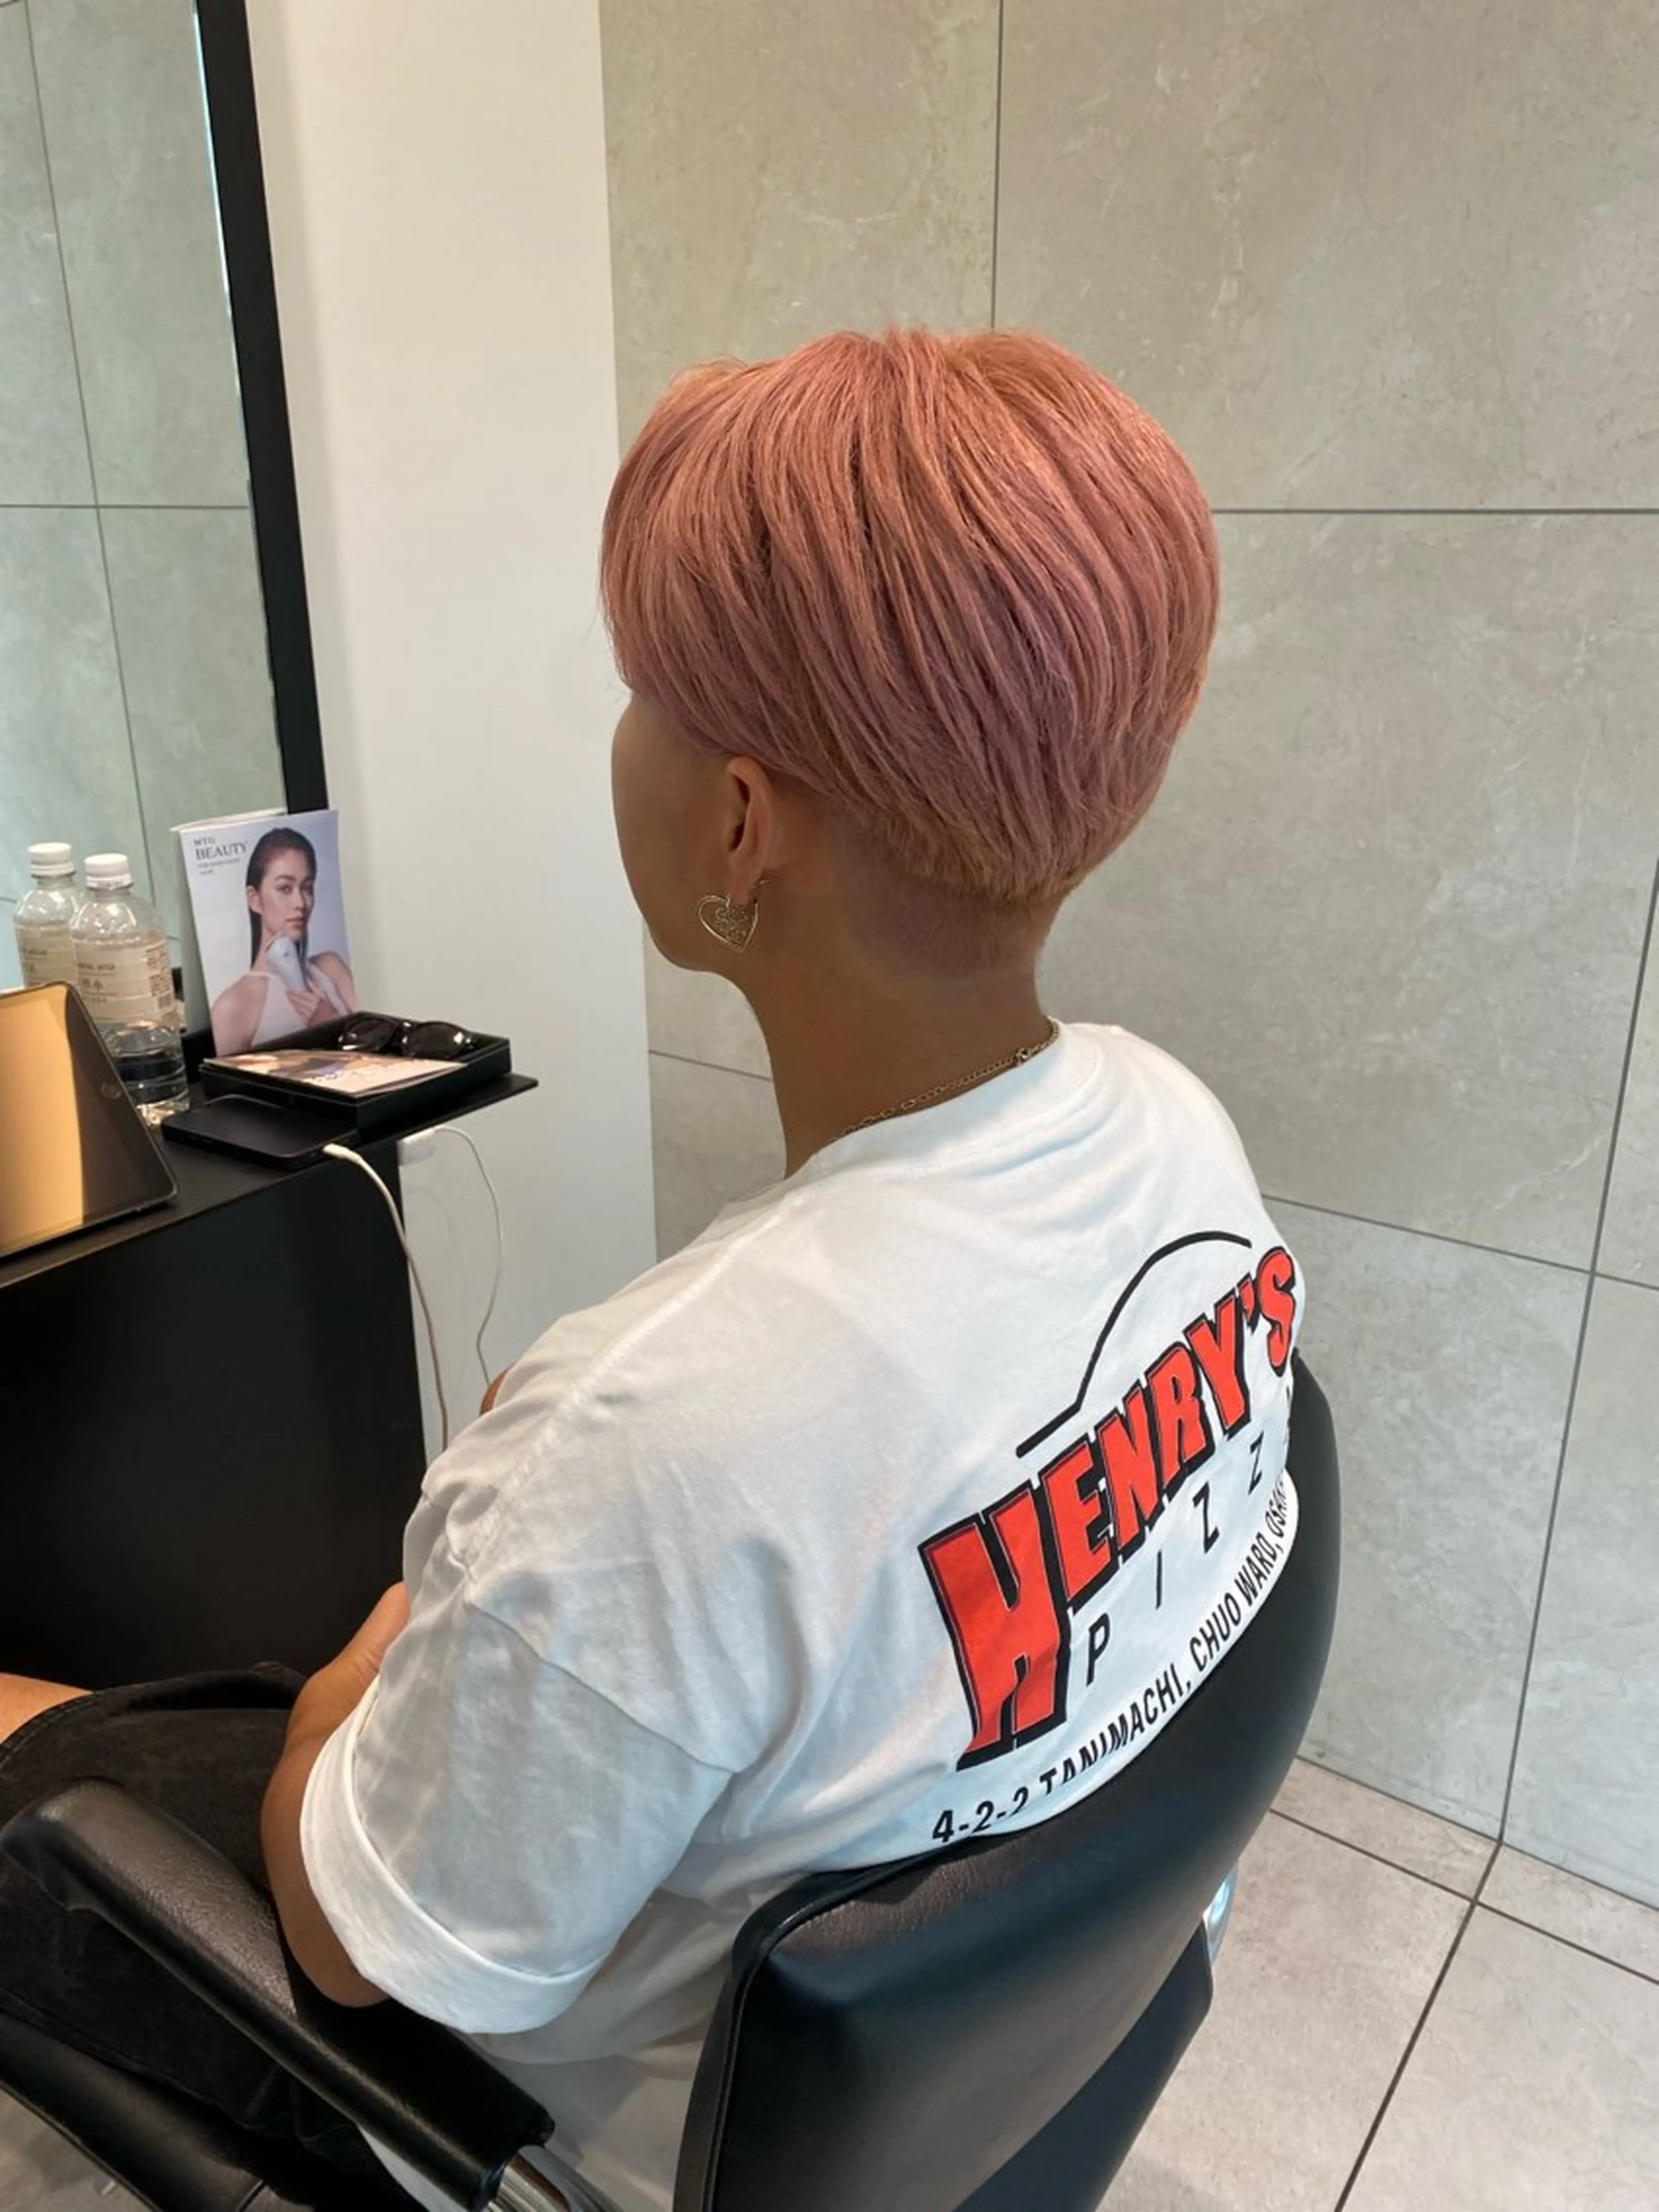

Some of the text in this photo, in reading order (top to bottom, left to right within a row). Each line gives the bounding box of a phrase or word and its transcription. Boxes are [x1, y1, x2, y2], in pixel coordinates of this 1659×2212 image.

[196, 841, 247, 860] BEAUTY
[917, 1246, 1296, 1771] HENRY'S
[932, 1786, 1029, 1843] 4-2-2
[1039, 1664, 1191, 1796] TANIMACHI,
[1189, 1592, 1241, 1672] CHUO
[1234, 1532, 1284, 1607] WARD,
